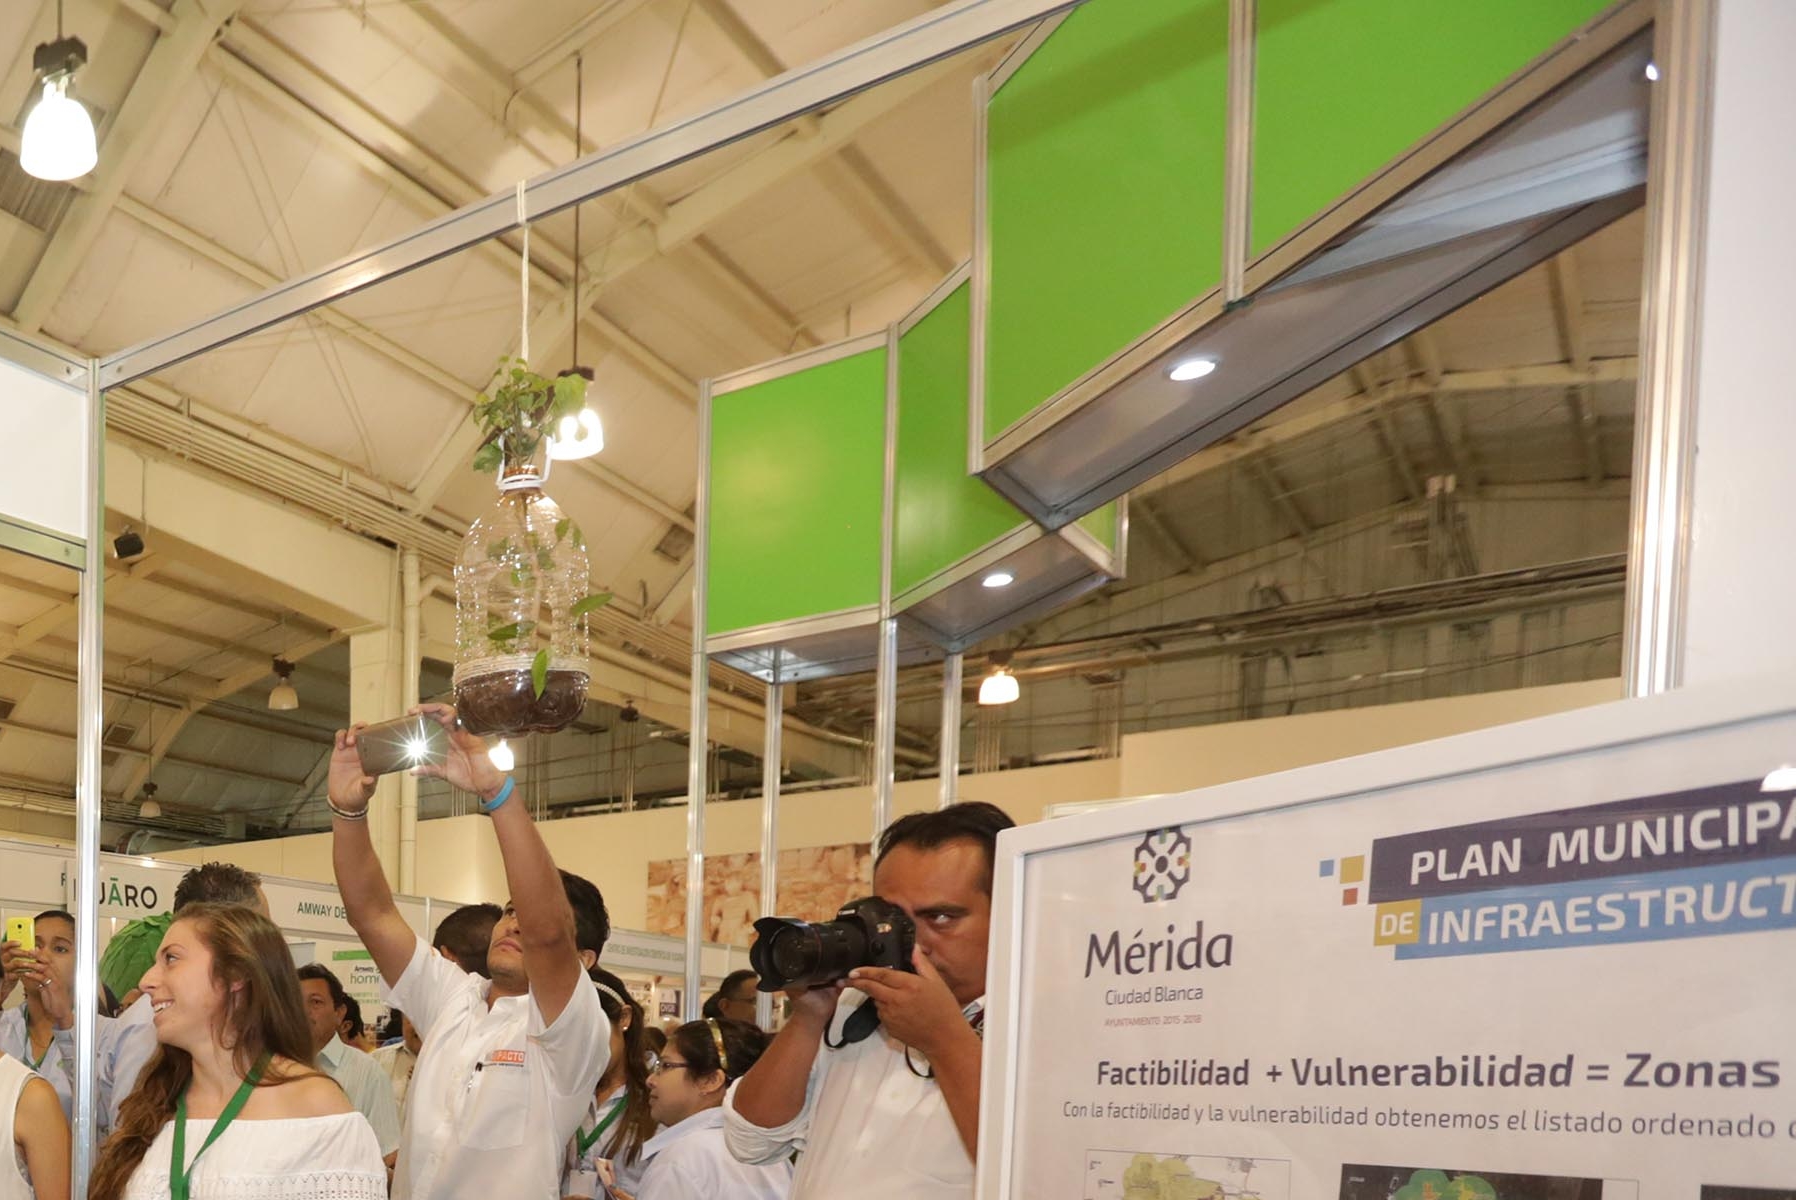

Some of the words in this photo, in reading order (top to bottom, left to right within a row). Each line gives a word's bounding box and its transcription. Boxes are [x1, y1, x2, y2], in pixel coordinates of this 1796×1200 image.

[1410, 838, 1522, 885] PLAN
[297, 902, 332, 917] AMWAY
[1380, 912, 1414, 936] DE
[1084, 920, 1233, 978] Mérida
[1105, 987, 1151, 1005] Ciudad
[1154, 986, 1203, 1003] Blanca
[1097, 1058, 1250, 1086] Factibilidad
[1266, 1065, 1282, 1083] +
[1291, 1054, 1574, 1088] Vulnerabilidad
[1586, 1064, 1609, 1081] =
[1623, 1053, 1781, 1088] Zonas
[1063, 1102, 1088, 1118] Con
[1091, 1102, 1104, 1118] la
[1108, 1102, 1190, 1121] factibilidad
[1194, 1107, 1205, 1125] y
[1208, 1104, 1224, 1122] la
[1229, 1105, 1368, 1126] vulnerabilidad
[1375, 1106, 1499, 1130] obtenemos
[1507, 1110, 1528, 1131] el
[1534, 1110, 1622, 1134] listado
[1631, 1112, 1776, 1139] ordenado
